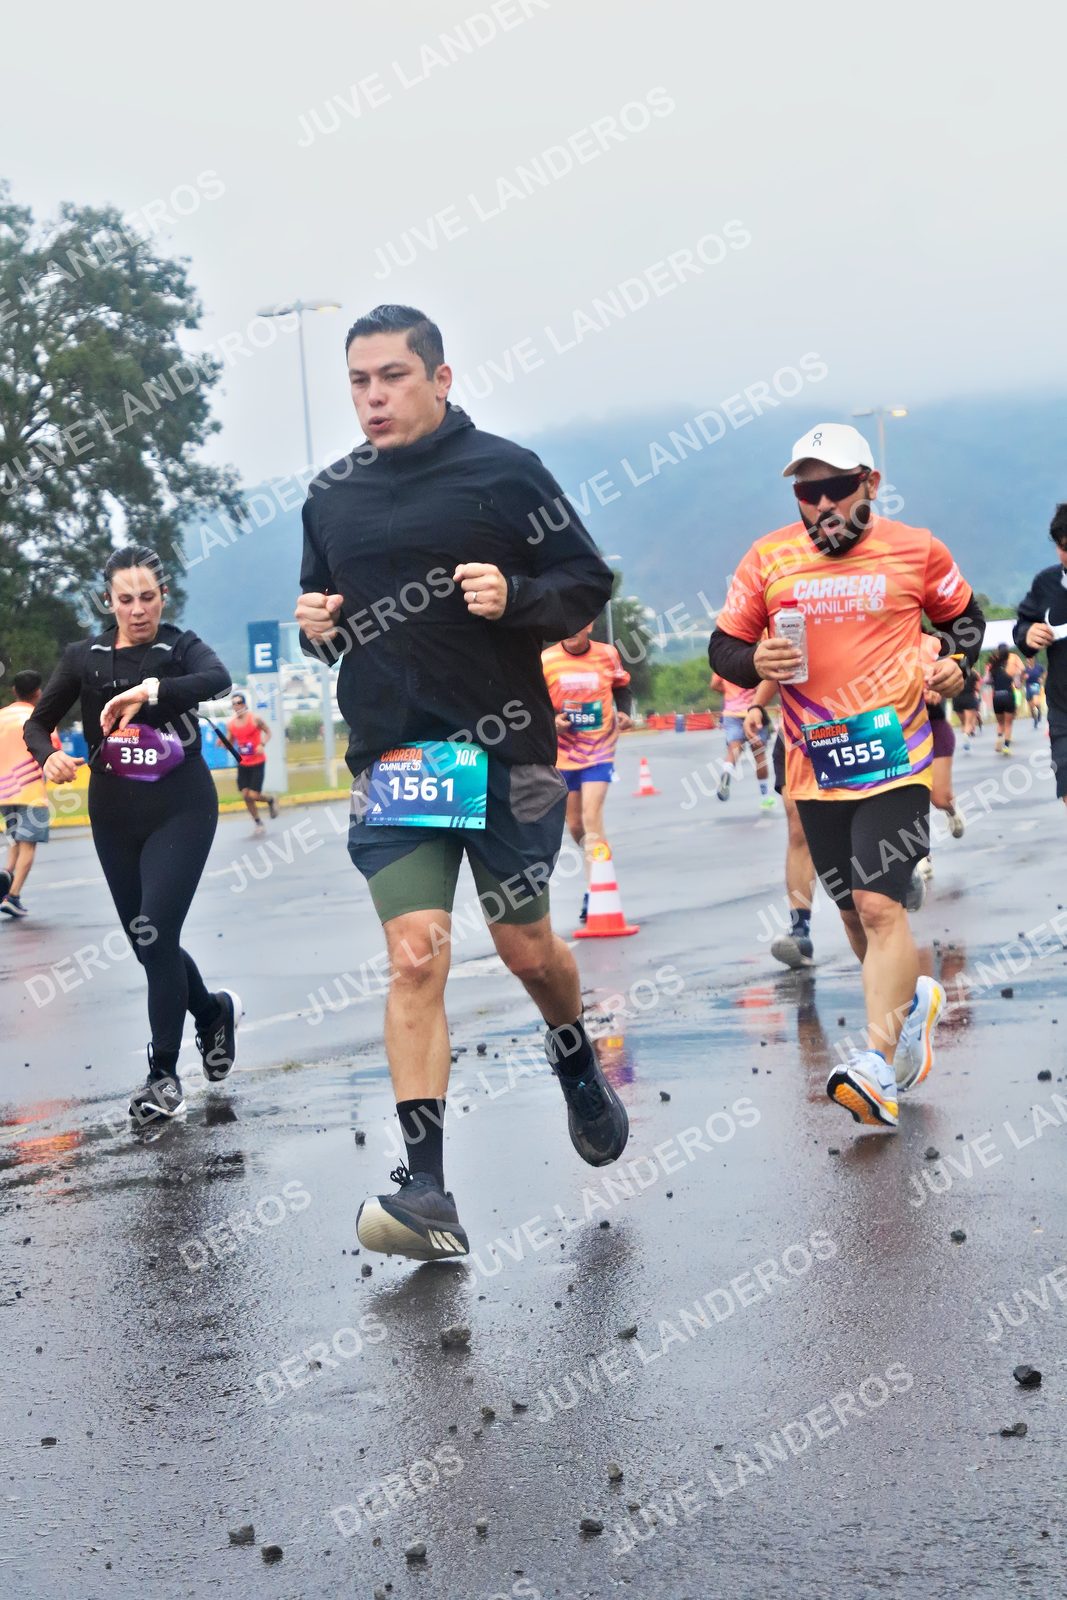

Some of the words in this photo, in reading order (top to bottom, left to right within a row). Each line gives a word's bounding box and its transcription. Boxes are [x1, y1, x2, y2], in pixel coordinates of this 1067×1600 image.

[793, 574, 887, 601] CARRERA
[254, 643, 273, 668] E
[569, 713, 596, 724] 1596
[873, 712, 893, 730] 10K
[810, 724, 848, 741] CARRERA
[121, 747, 157, 765] 338
[381, 748, 423, 762] CARRERA
[456, 750, 480, 766] 10K
[828, 739, 886, 768] 1555
[389, 776, 455, 802] 1561
